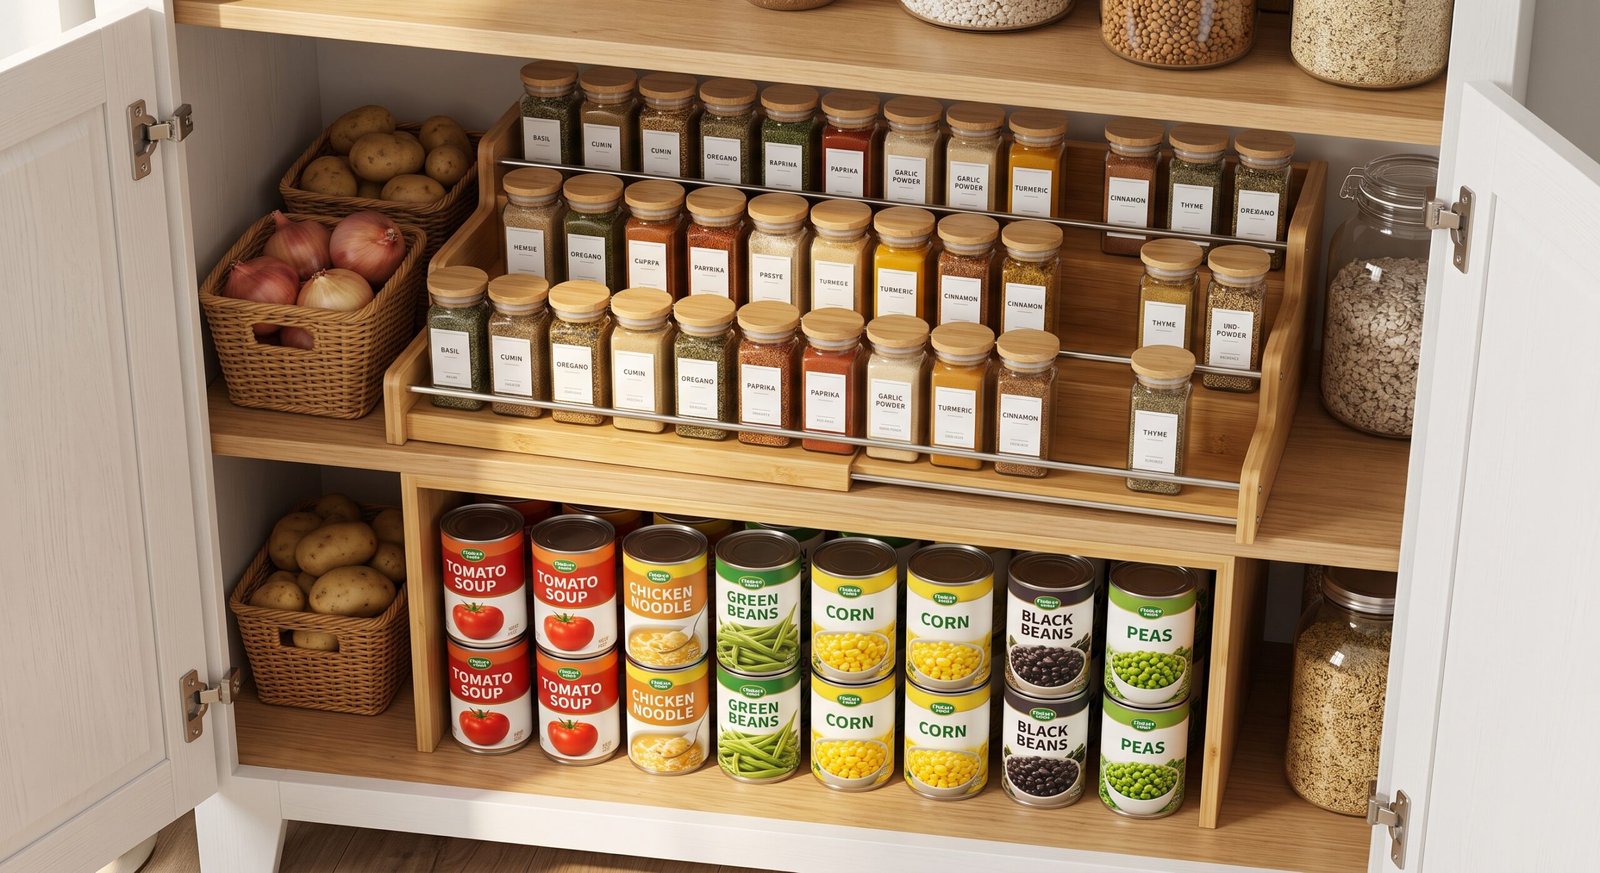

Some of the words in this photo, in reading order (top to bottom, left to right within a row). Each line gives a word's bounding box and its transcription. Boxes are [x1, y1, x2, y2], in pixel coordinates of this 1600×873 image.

[592, 141, 612, 149] CUMIN
[706, 153, 737, 162] OREGANO
[831, 166, 858, 174] PAPRIKA
[895, 169, 918, 177] GARLIC
[892, 177, 921, 185] POWDER
[957, 175, 980, 183] GARLIC
[954, 183, 983, 191] POWDER
[1015, 185, 1048, 194] TURMERIC
[1110, 195, 1146, 203] CINNAMON
[1181, 202, 1203, 210] THYME
[570, 251, 602, 260] OREGANO
[879, 286, 913, 295] TURMERIC
[944, 293, 978, 303] CINNAMON
[1008, 301, 1043, 310] CINNAMON
[1152, 320, 1176, 328] THYME
[1216, 330, 1246, 338] POWDER
[441, 346, 459, 355] BASIL
[500, 353, 522, 362] CUMIN
[557, 362, 588, 370] OREGANO
[623, 368, 645, 376] CUMIN
[682, 375, 714, 385] OREGANO
[747, 382, 776, 391] PAPRIKA
[810, 389, 840, 398] PAPRIKA
[878, 393, 903, 401] GARLIC
[876, 401, 906, 410] POWDER
[938, 404, 972, 414] TURMERIC
[1002, 412, 1039, 422] CINNAMON
[1143, 429, 1168, 438] THYME
[446, 559, 507, 578] TOMATO
[537, 570, 598, 588] TOMATO
[455, 577, 496, 592] SOUP
[546, 588, 588, 603] SOUP
[630, 582, 692, 601] CHICKEN
[727, 591, 778, 605] GREEN
[631, 596, 692, 613] NOODLE
[727, 605, 778, 620] BEANS
[826, 605, 875, 622] CORN
[920, 612, 970, 629] CORN
[1021, 610, 1073, 627] BLACK
[1021, 624, 1073, 640] BEANS
[1126, 626, 1173, 643] PEAS
[452, 667, 513, 685] TOMATO
[541, 676, 602, 696] TOMATO
[461, 684, 503, 699] SOUP
[550, 695, 592, 710] SOUP
[632, 689, 695, 708] CHICKEN
[728, 699, 779, 713] GREEN
[633, 704, 694, 720] NOODLE
[728, 712, 779, 728] BEANS
[826, 713, 874, 730] CORN
[919, 721, 967, 738] CORN
[1017, 720, 1068, 737] BLACK
[1016, 735, 1068, 752] BEANS
[1121, 738, 1166, 755] PEAS
